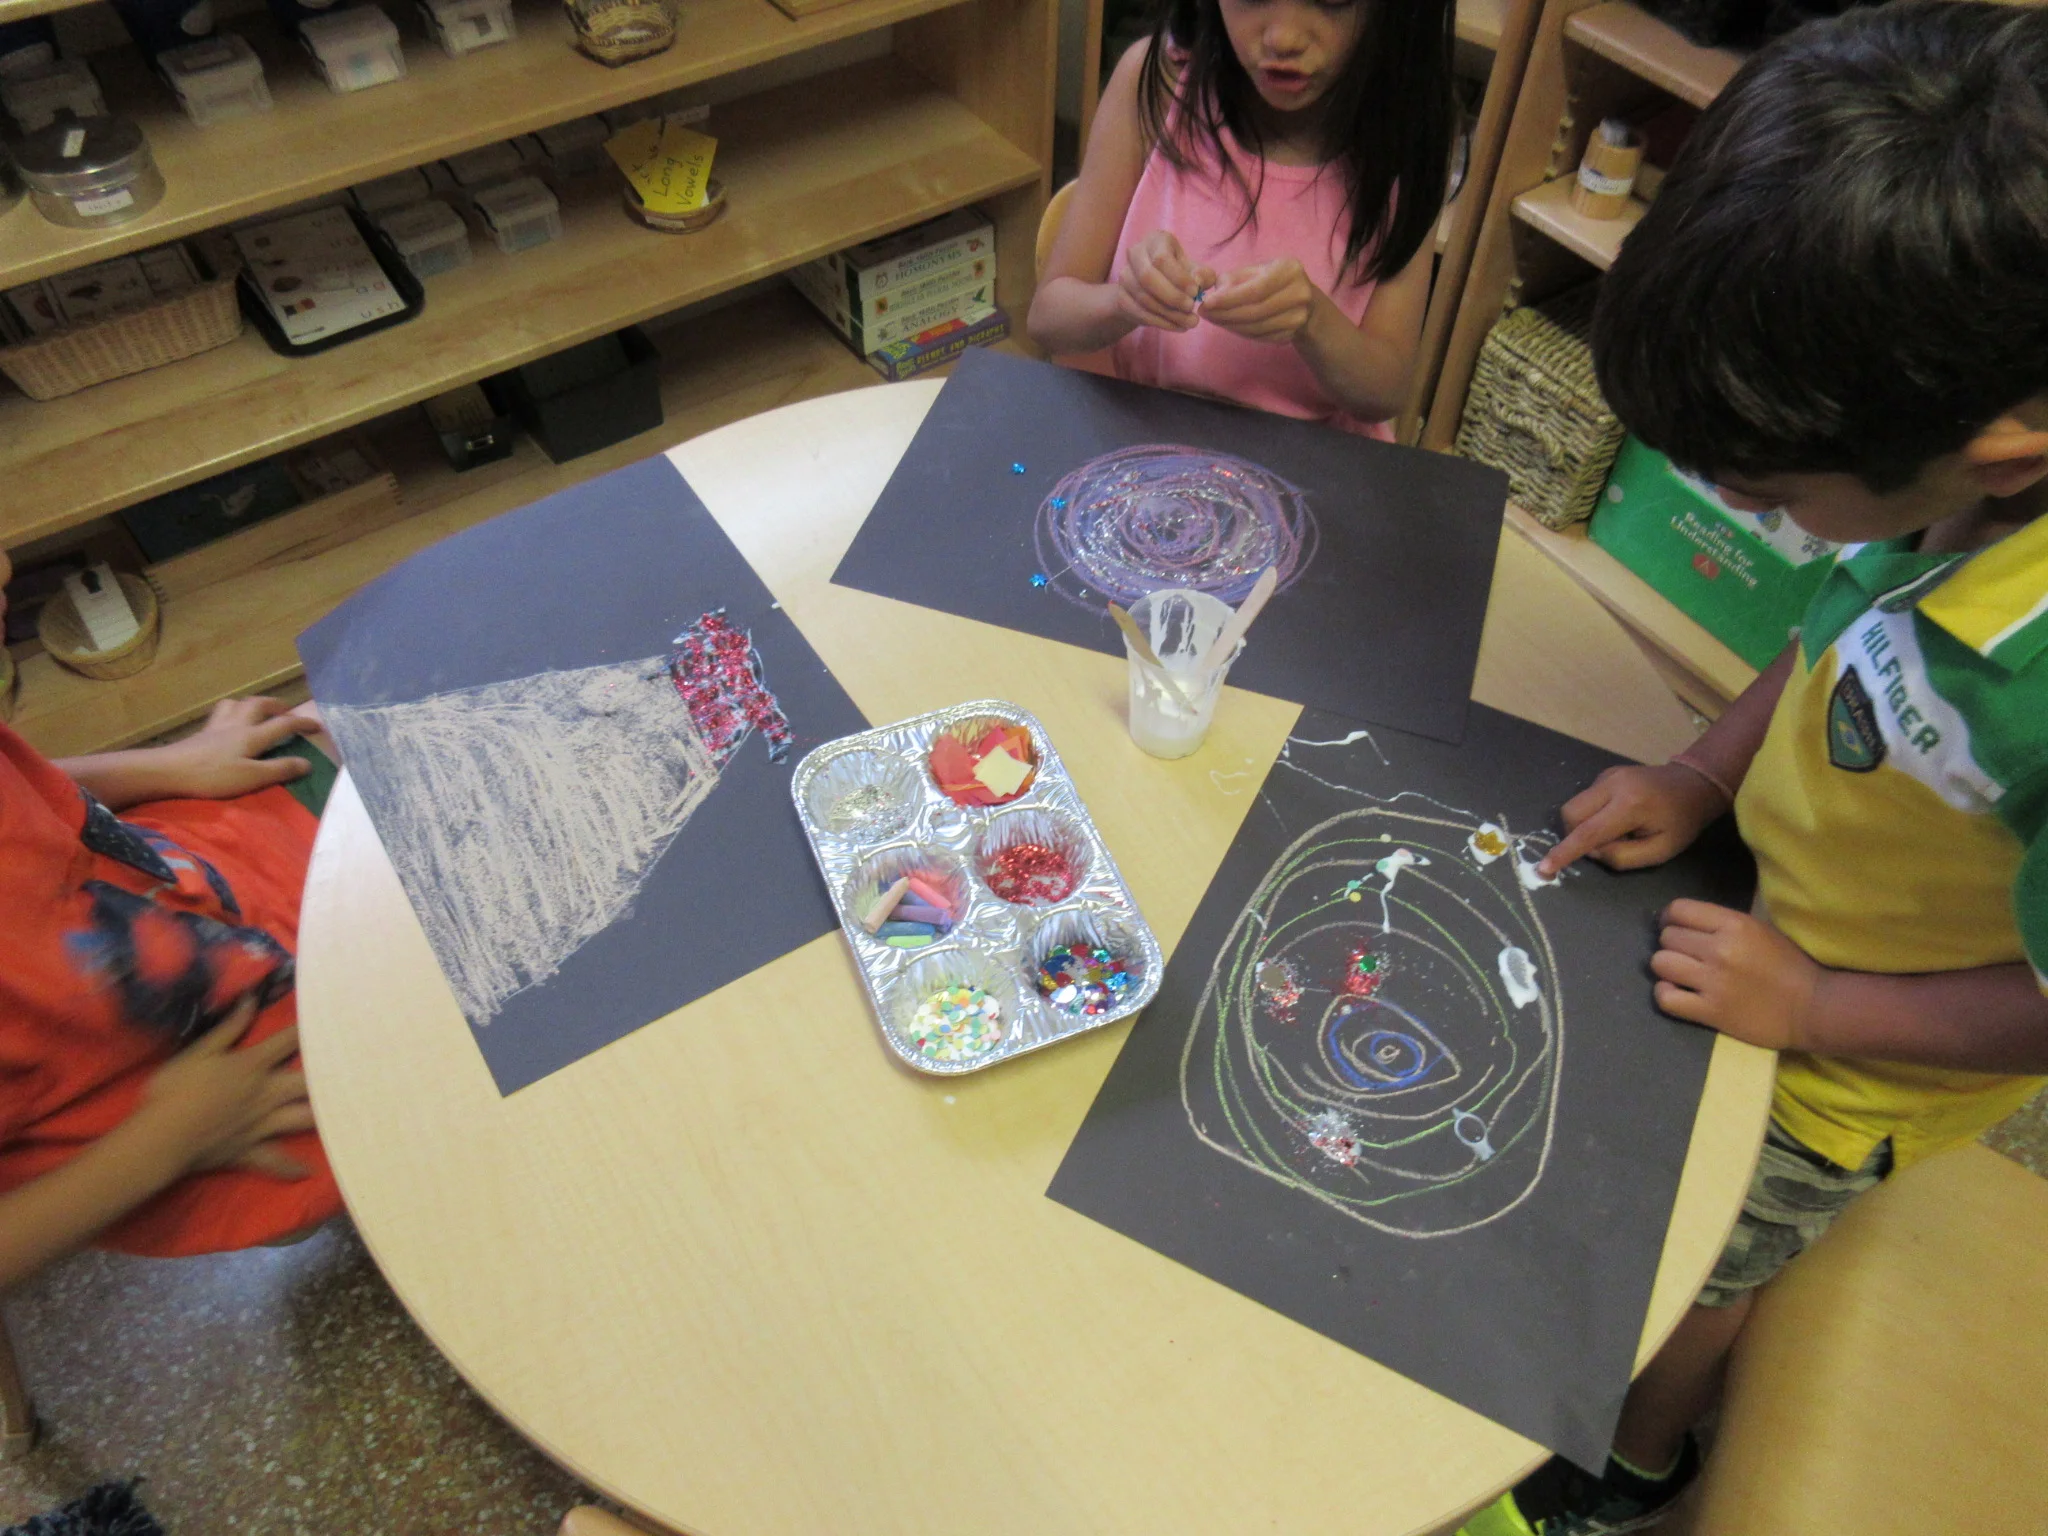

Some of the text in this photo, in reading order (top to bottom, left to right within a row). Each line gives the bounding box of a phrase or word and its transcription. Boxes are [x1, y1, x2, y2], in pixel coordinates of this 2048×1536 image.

[652, 156, 684, 197] Long
[675, 154, 705, 205] Vowels
[895, 249, 962, 281] HOMONYMS
[903, 304, 957, 333] ANALOGY
[1670, 514, 1758, 589] Understanding
[1684, 511, 1734, 557] Reading
[1734, 548, 1755, 569] for
[1860, 620, 1941, 755] HILFIGER
